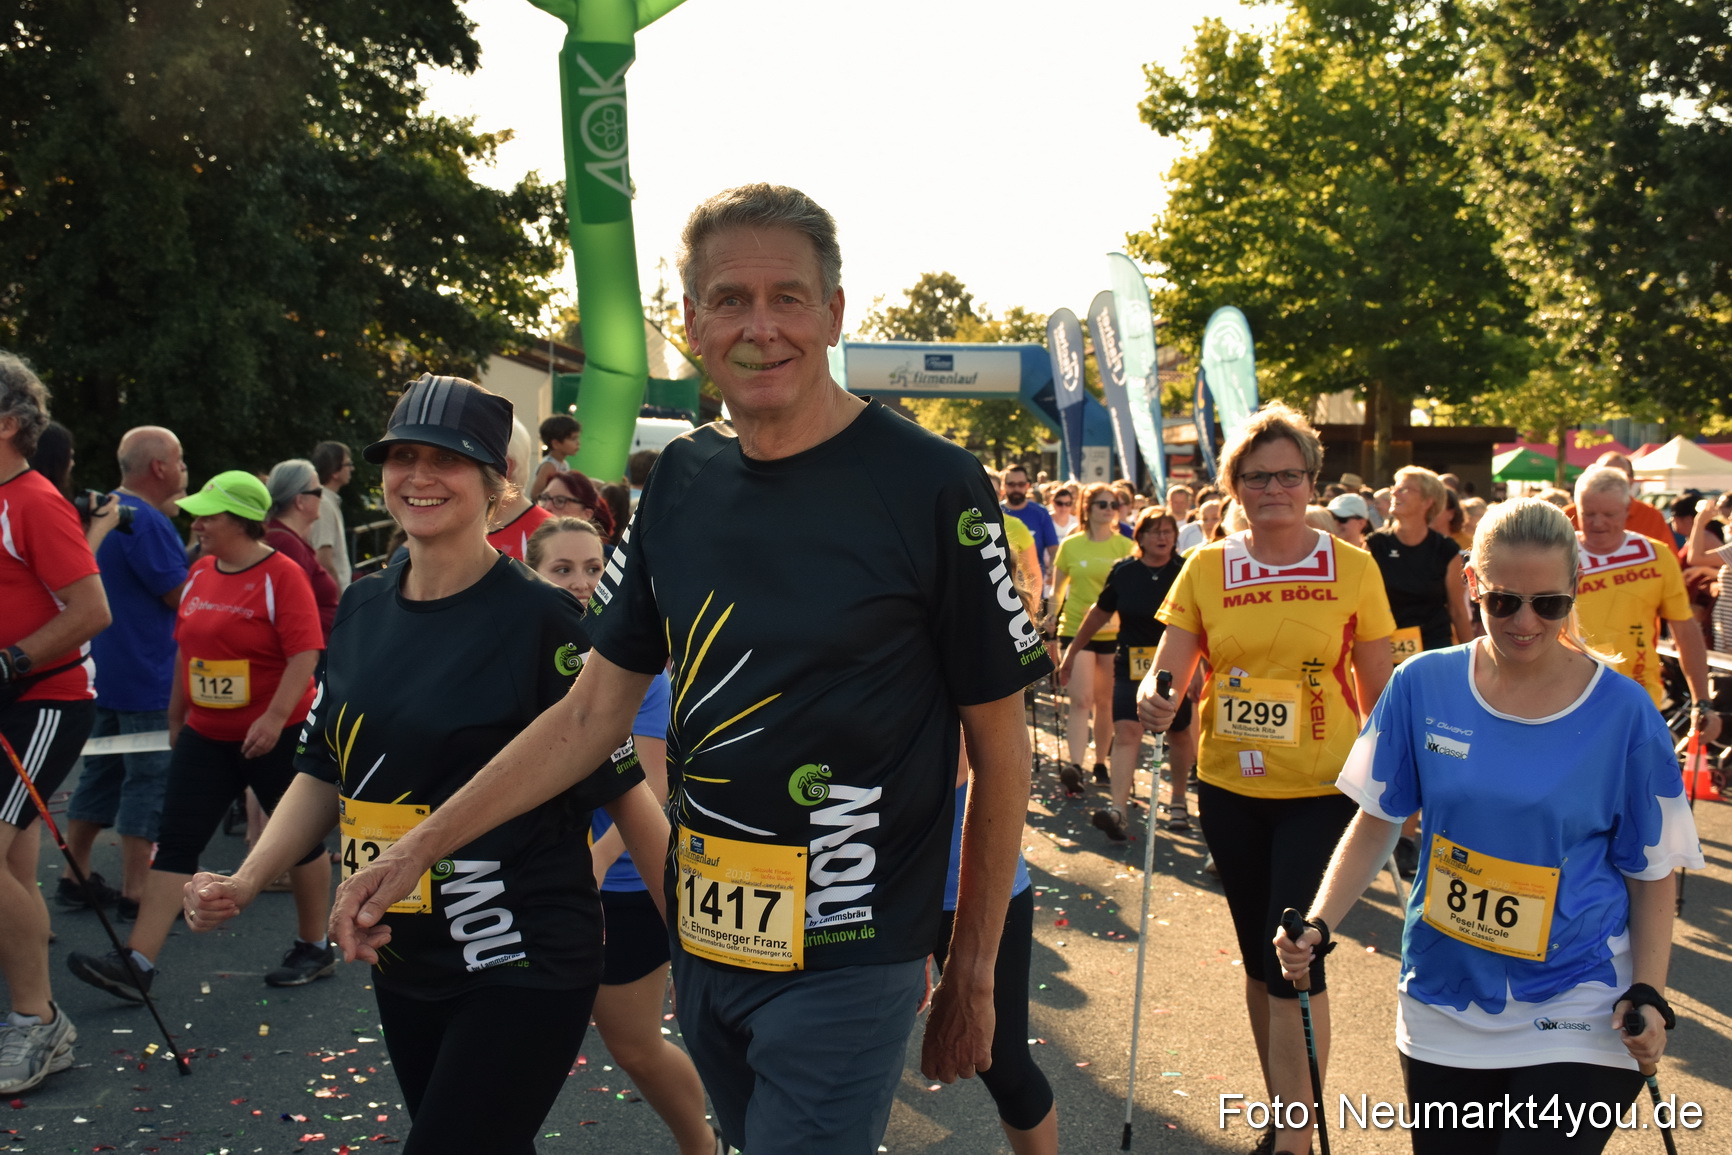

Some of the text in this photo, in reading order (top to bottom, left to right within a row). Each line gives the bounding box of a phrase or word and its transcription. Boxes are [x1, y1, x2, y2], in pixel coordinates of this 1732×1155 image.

[576, 53, 636, 200] AOK
[913, 371, 978, 385] firmenlauf
[1612, 567, 1662, 586] BÖGL
[1223, 585, 1339, 608] MAX BÖGL
[199, 676, 233, 695] 112
[1223, 698, 1288, 727] 1299
[1262, 726, 1276, 734] Rita
[685, 847, 720, 867] firmenlauf
[1443, 854, 1483, 876] firmenlauf
[725, 868, 751, 881] 2018
[685, 874, 781, 933] 1417
[1446, 879, 1520, 928] 816
[809, 910, 867, 928] by Lammsbräu
[1450, 912, 1475, 929] Pesel
[1477, 921, 1509, 939] Nicole
[681, 915, 788, 950] Dr. Ehrnsperger Franz
[1458, 926, 1496, 943] IKK classic
[698, 936, 726, 949] Lammsbräu
[726, 943, 742, 952] Gebr.
[743, 946, 781, 958] Ehrnsperger
[1558, 1021, 1591, 1031] classic
